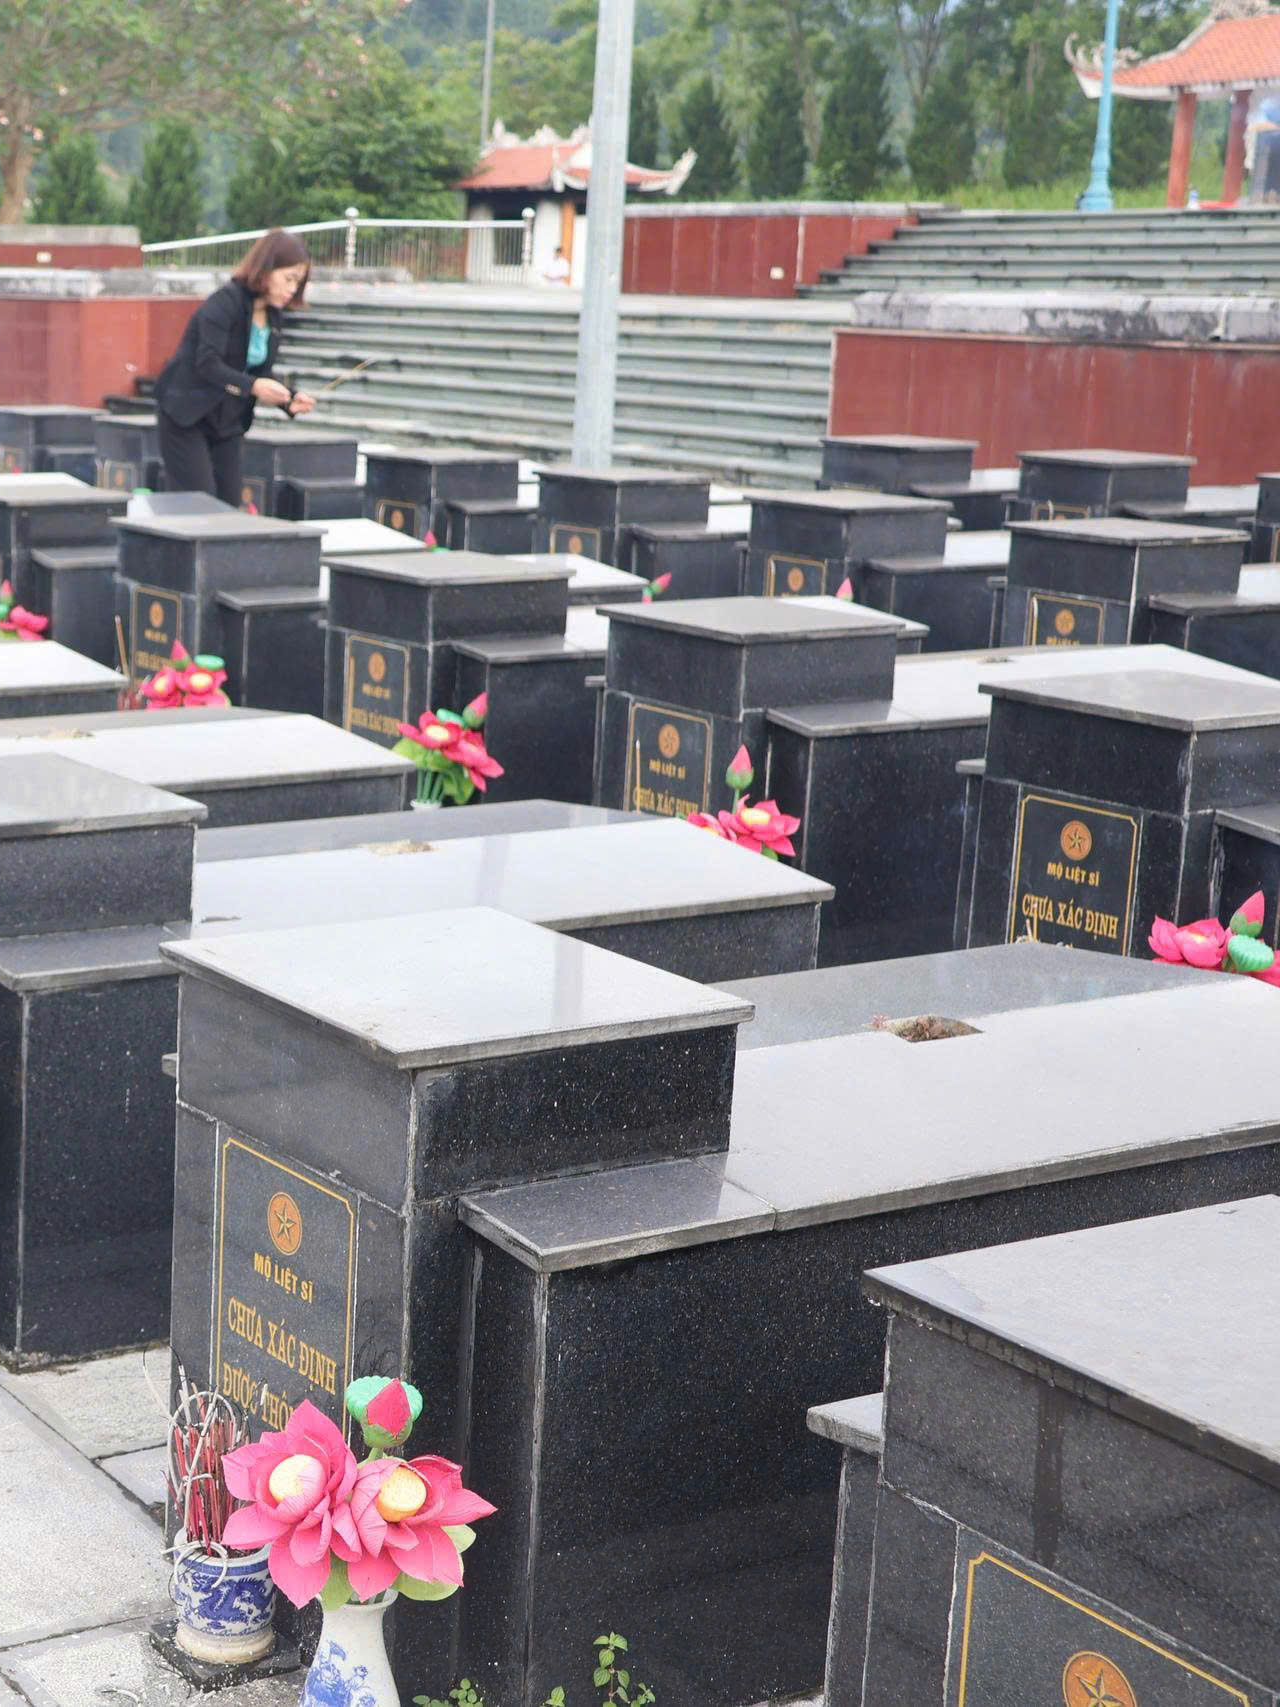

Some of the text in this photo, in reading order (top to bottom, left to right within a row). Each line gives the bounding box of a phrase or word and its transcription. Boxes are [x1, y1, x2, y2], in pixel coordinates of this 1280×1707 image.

[1047, 862, 1063, 880] MỘ
[1065, 866, 1086, 885] LIỆT
[1022, 893, 1120, 941] CHƯA XÁC ĐỊNH
[254, 1252, 272, 1282] MỘ
[274, 1264, 299, 1295] LIỆT
[228, 1296, 337, 1396] CHƯA XÁC ĐỊNH
